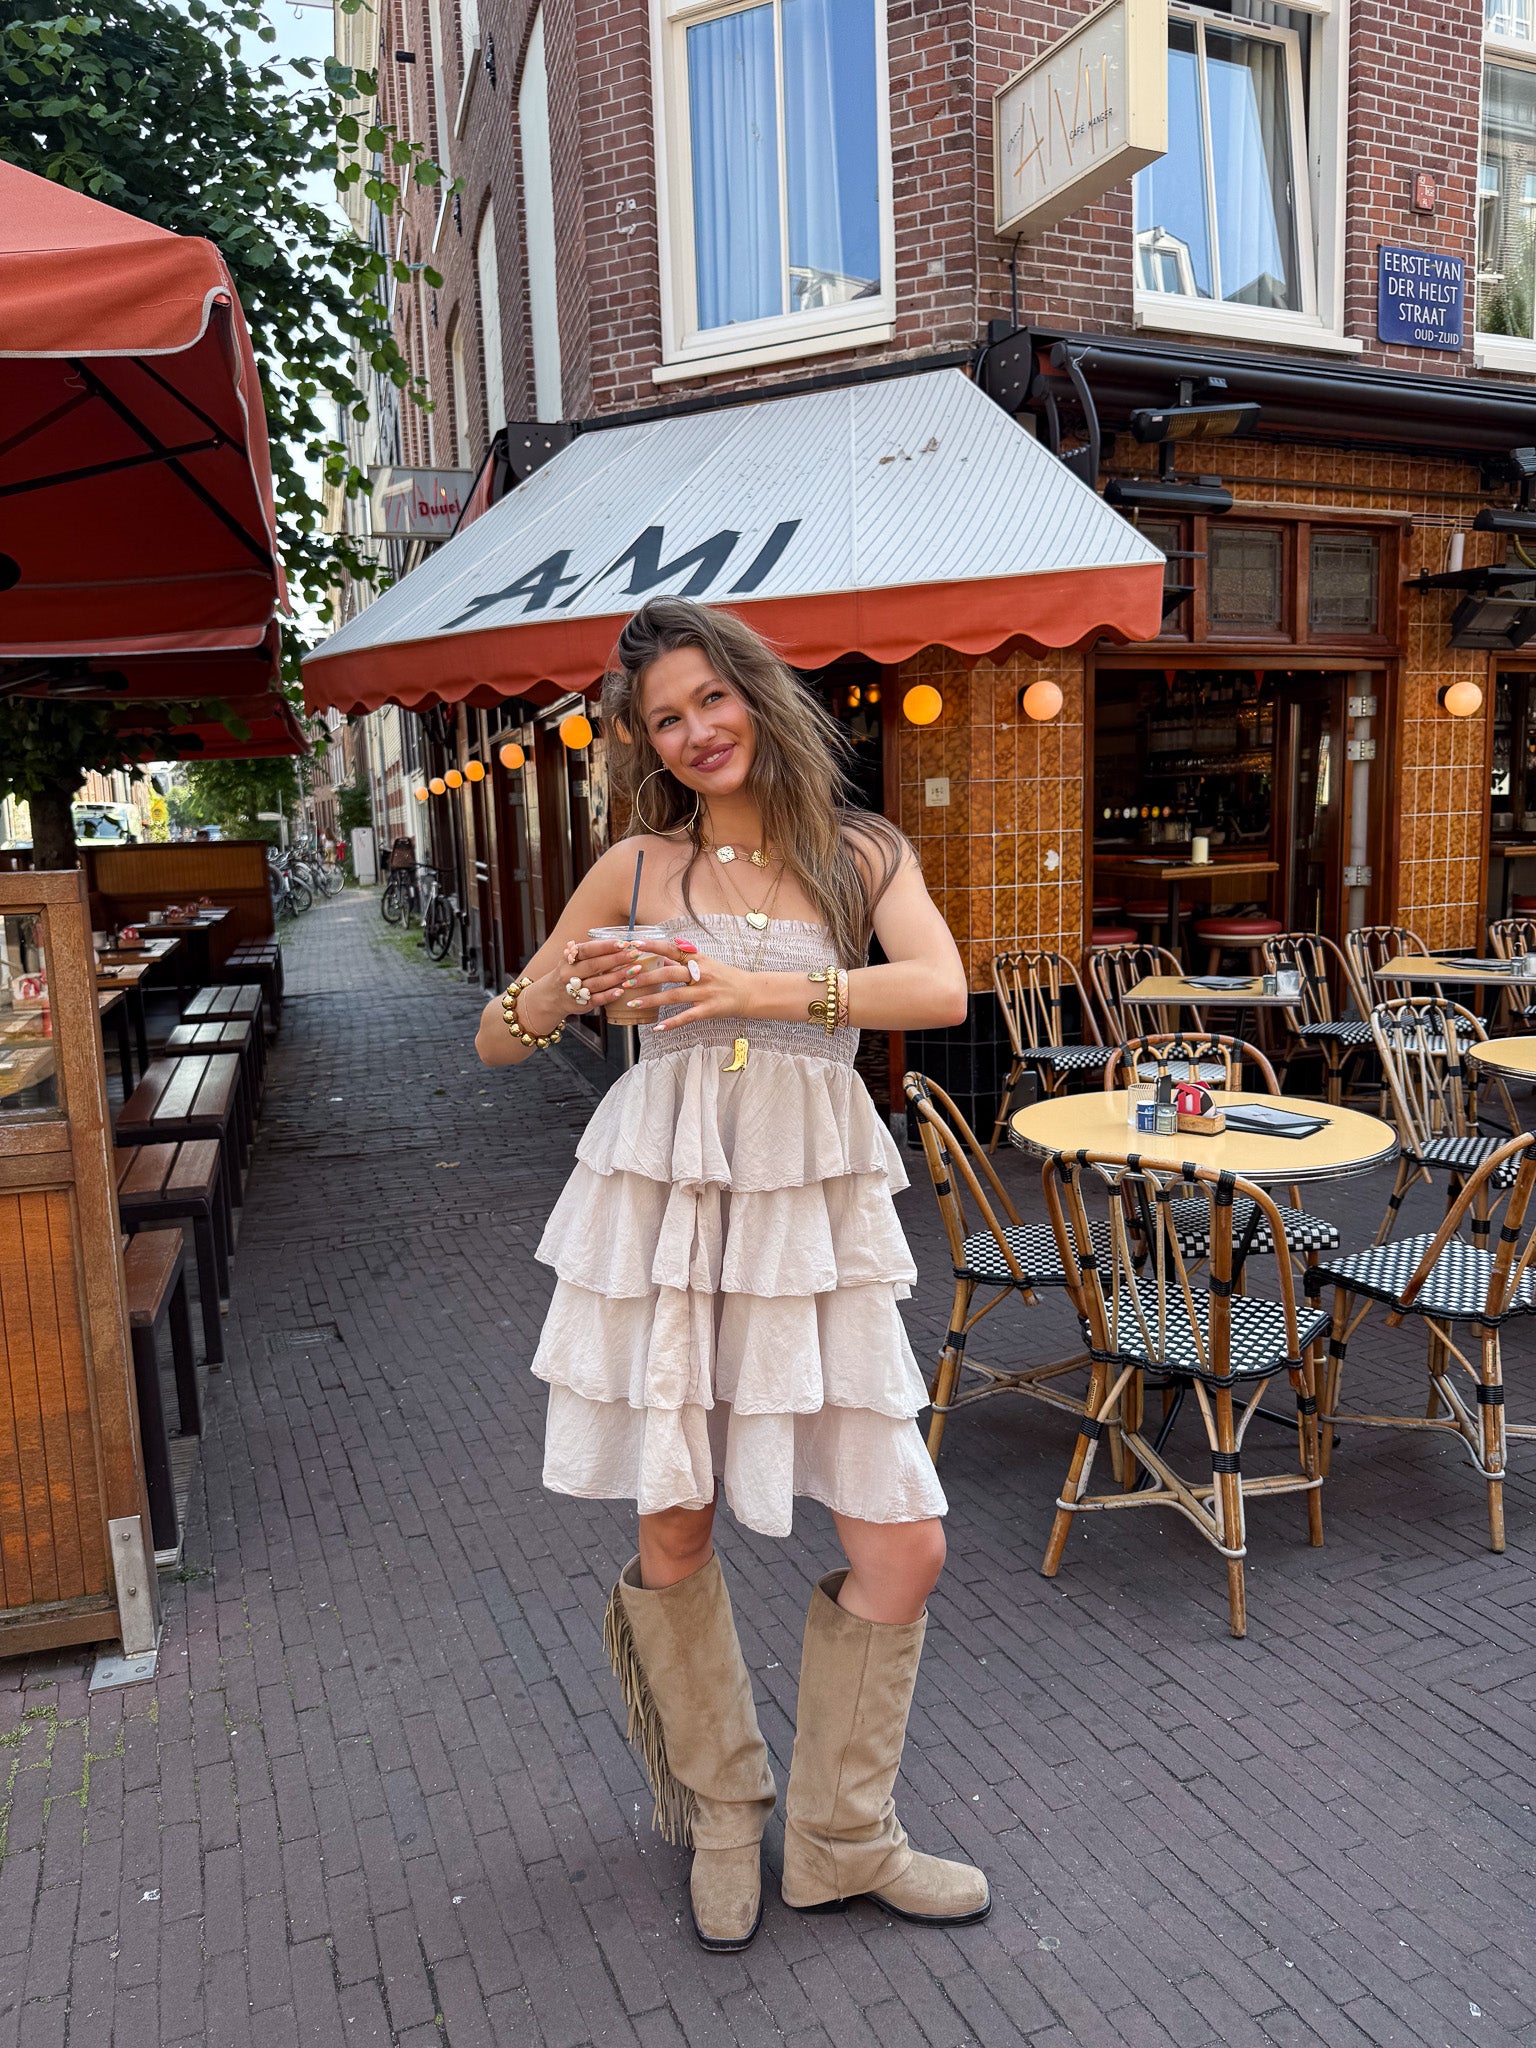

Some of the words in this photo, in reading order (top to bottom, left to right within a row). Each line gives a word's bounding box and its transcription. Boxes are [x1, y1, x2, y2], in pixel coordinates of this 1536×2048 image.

[1384, 252, 1431, 277] EERSTE
[1434, 260, 1461, 282] VAN
[1388, 276, 1415, 299] DER
[1419, 281, 1458, 305] HELST
[1398, 303, 1447, 327] STRAAT
[1414, 328, 1460, 345] OUD-ZUID
[418, 499, 461, 517] Duvel
[438, 519, 803, 630] AMI
